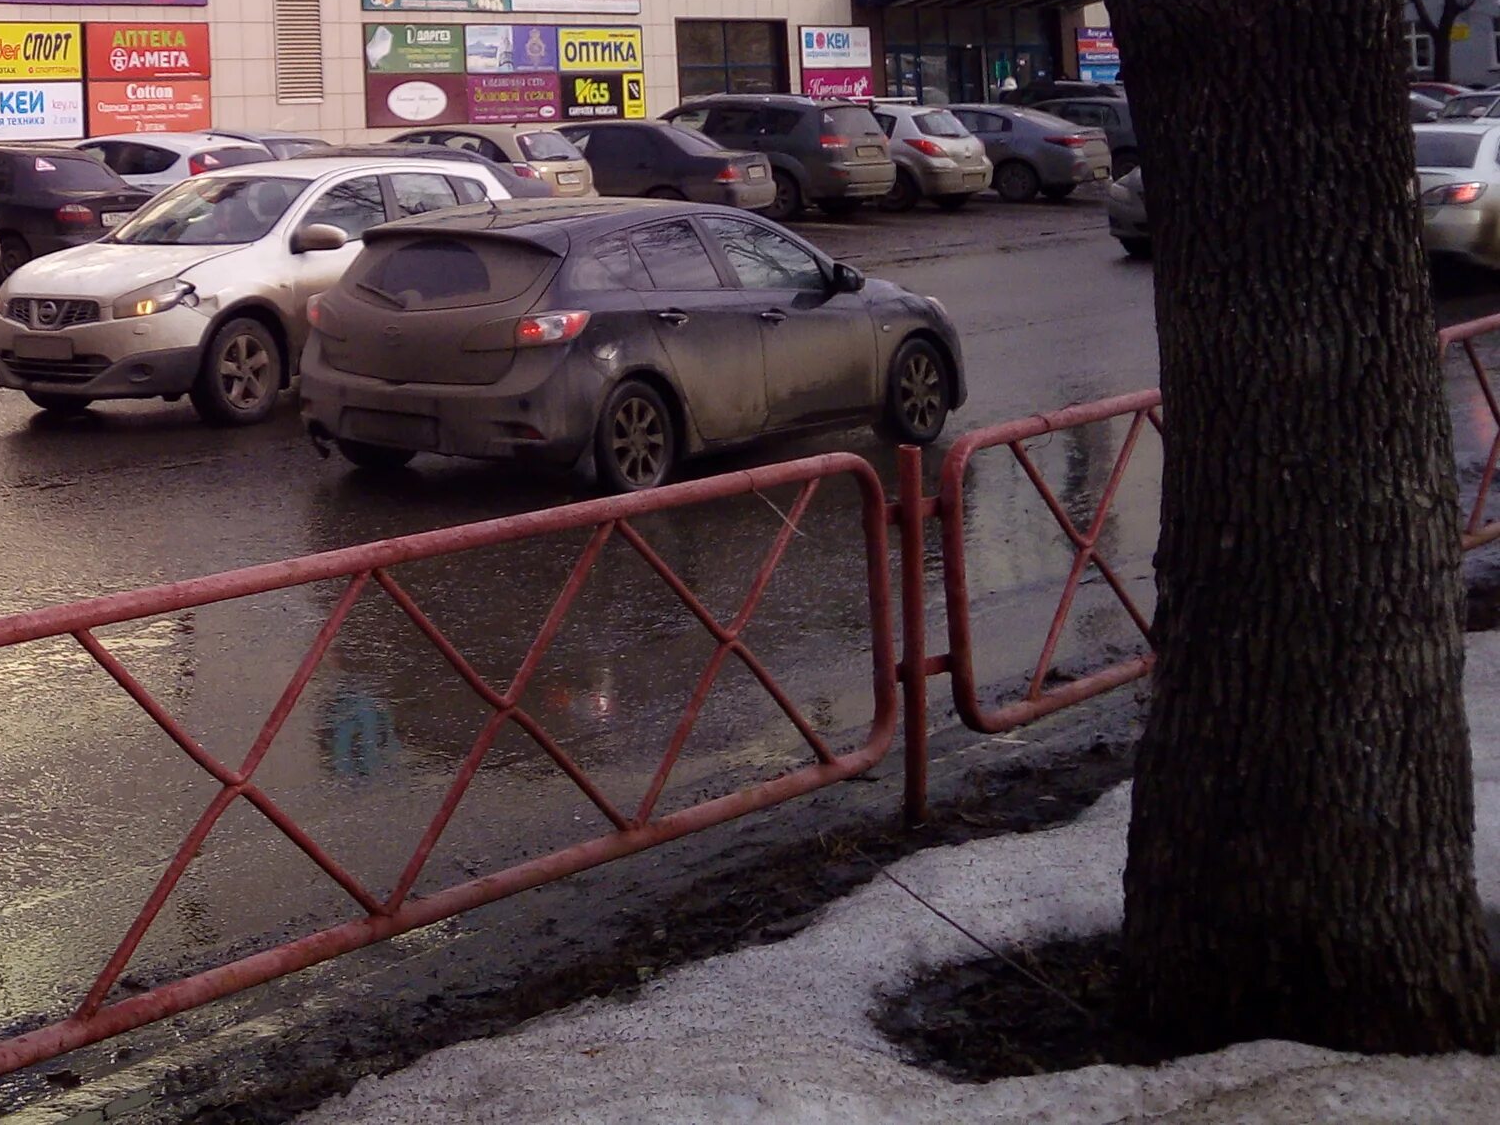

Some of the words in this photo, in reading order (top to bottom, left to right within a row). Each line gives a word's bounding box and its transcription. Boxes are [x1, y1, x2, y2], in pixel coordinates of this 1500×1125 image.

[23, 32, 72, 62] СПОРТ
[112, 30, 187, 47] АПТЕКА
[564, 41, 637, 63] ОПТИКА
[126, 83, 174, 99] Cotton
[8, 116, 45, 126] техника
